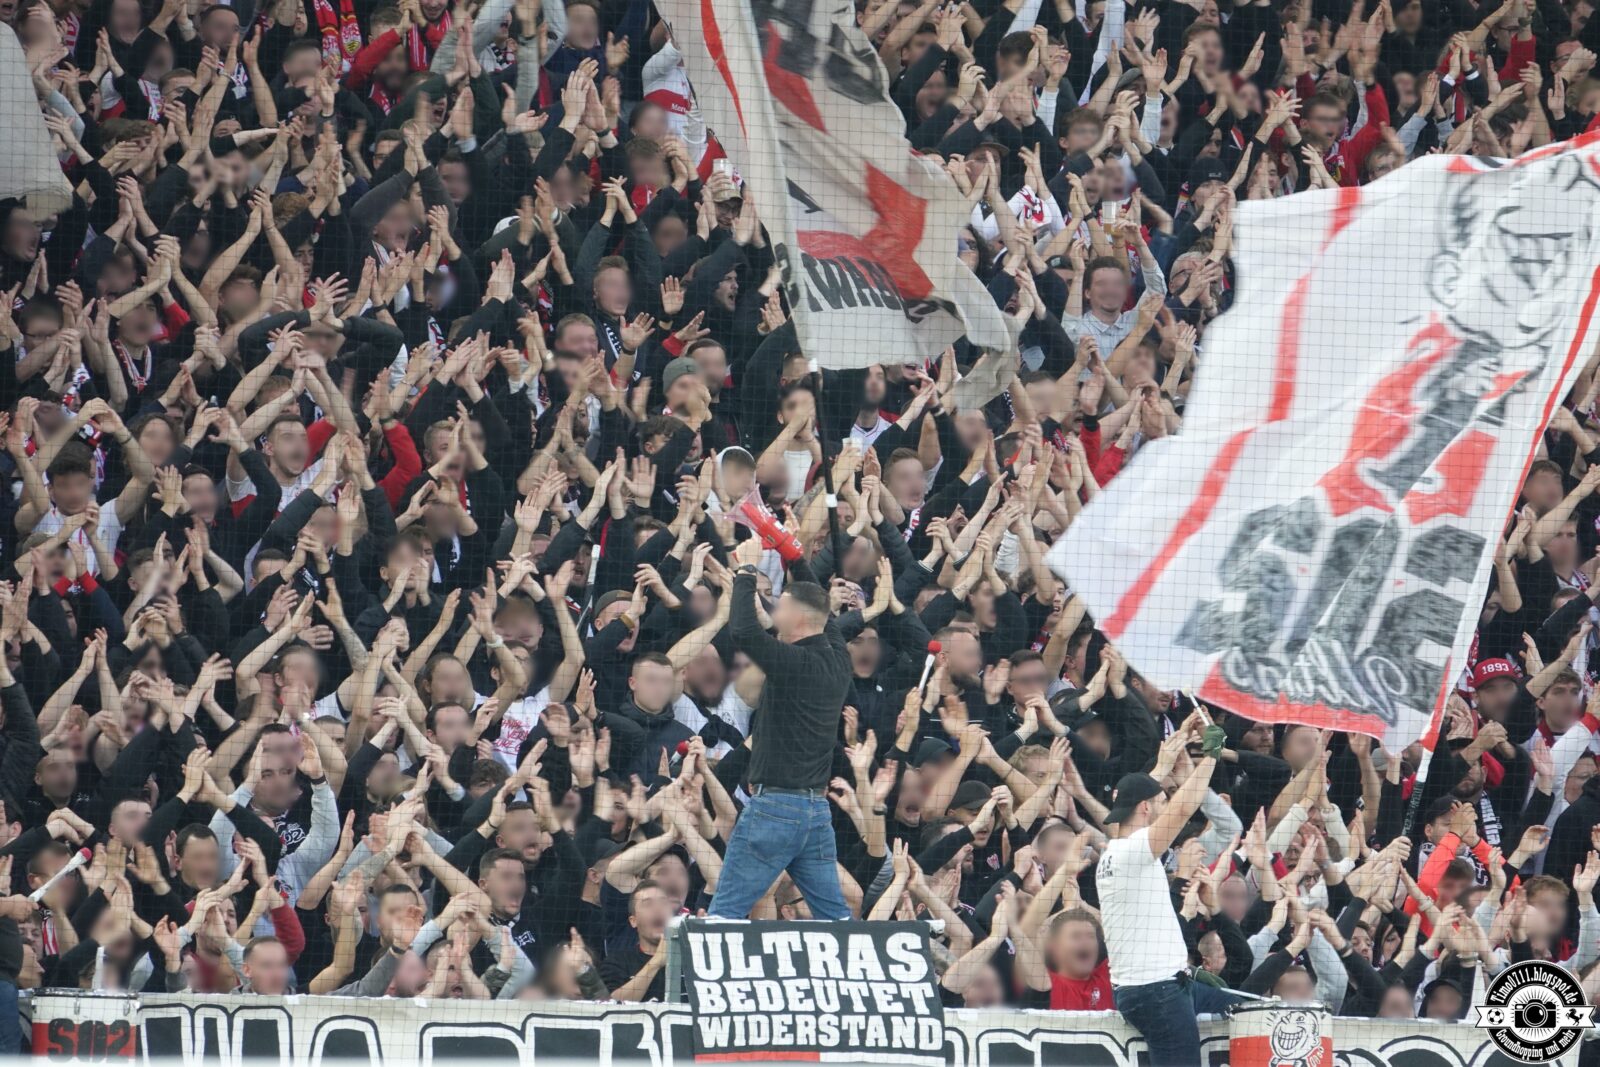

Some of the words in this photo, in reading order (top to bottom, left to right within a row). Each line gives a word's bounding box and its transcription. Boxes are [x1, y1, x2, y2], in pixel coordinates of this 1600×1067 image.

[1482, 662, 1509, 675] 1893
[687, 930, 929, 982] ULTRAS
[693, 978, 934, 1015] BEDEUTET
[48, 1017, 131, 1063] S02
[697, 1013, 943, 1051] WIDERSTAND
